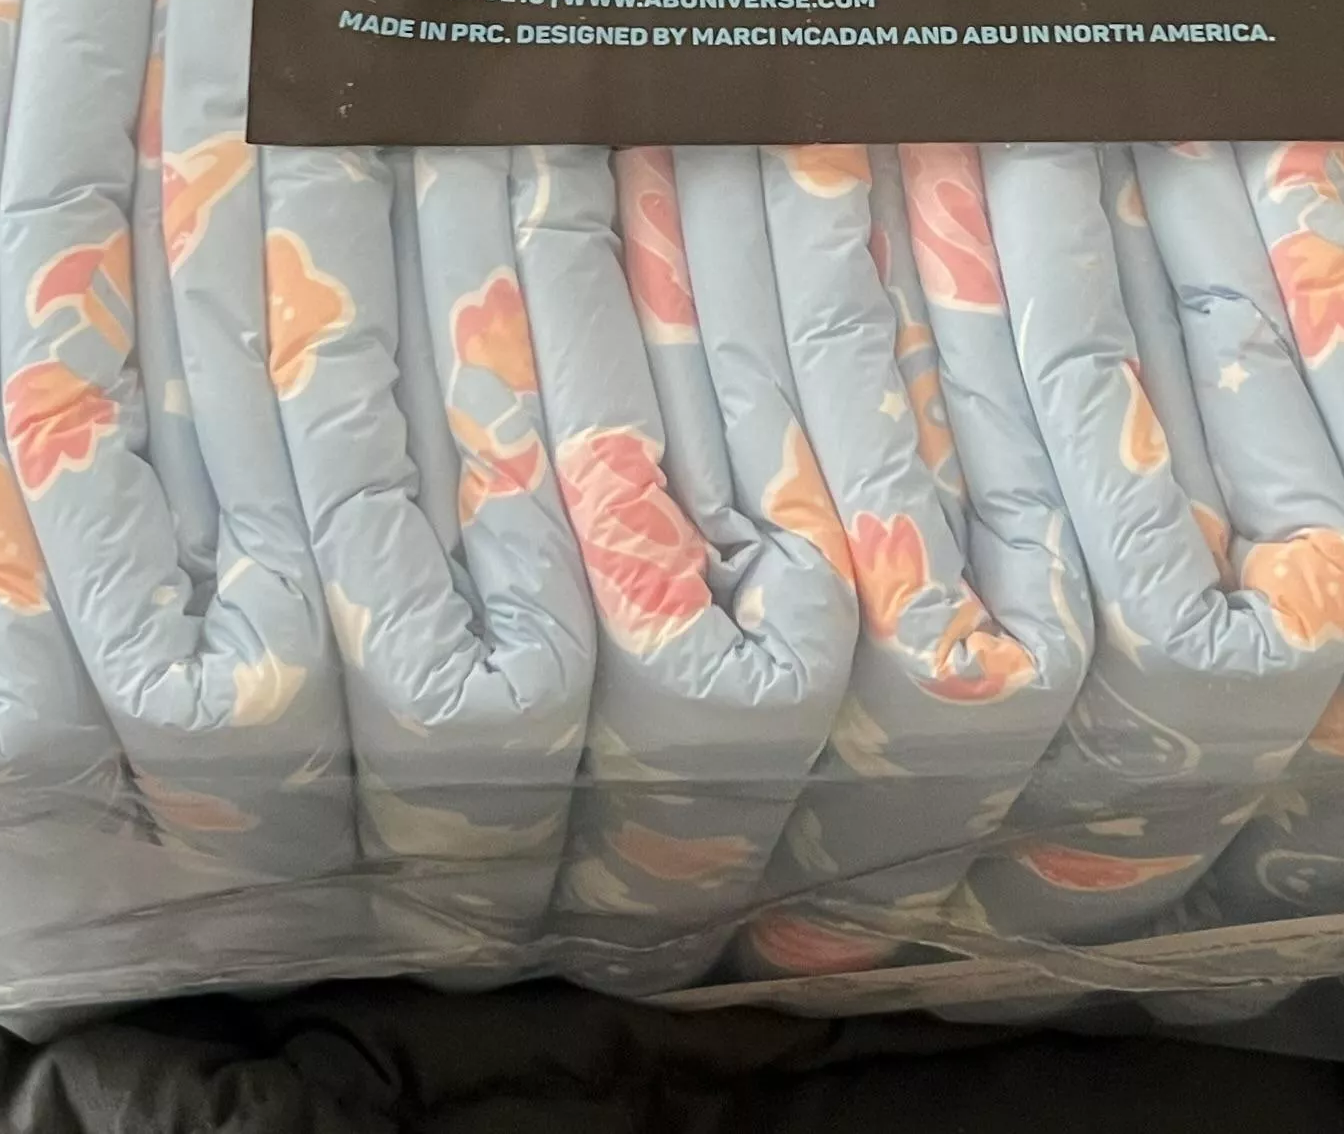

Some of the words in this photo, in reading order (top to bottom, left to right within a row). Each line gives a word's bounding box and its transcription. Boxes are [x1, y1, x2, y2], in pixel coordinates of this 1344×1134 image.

[338, 10, 415, 39] MADE
[419, 21, 448, 41] IN
[451, 23, 511, 44] PRC.
[516, 25, 649, 46] DESIGNED
[653, 27, 688, 46] BY
[692, 26, 776, 46] MARCI
[781, 26, 898, 46] MCADAM
[902, 26, 958, 45] AND
[962, 25, 1018, 45] ABU
[1022, 24, 1050, 44] IN
[1053, 23, 1145, 43] NORTH
[1149, 22, 1276, 42] AMERICA.
